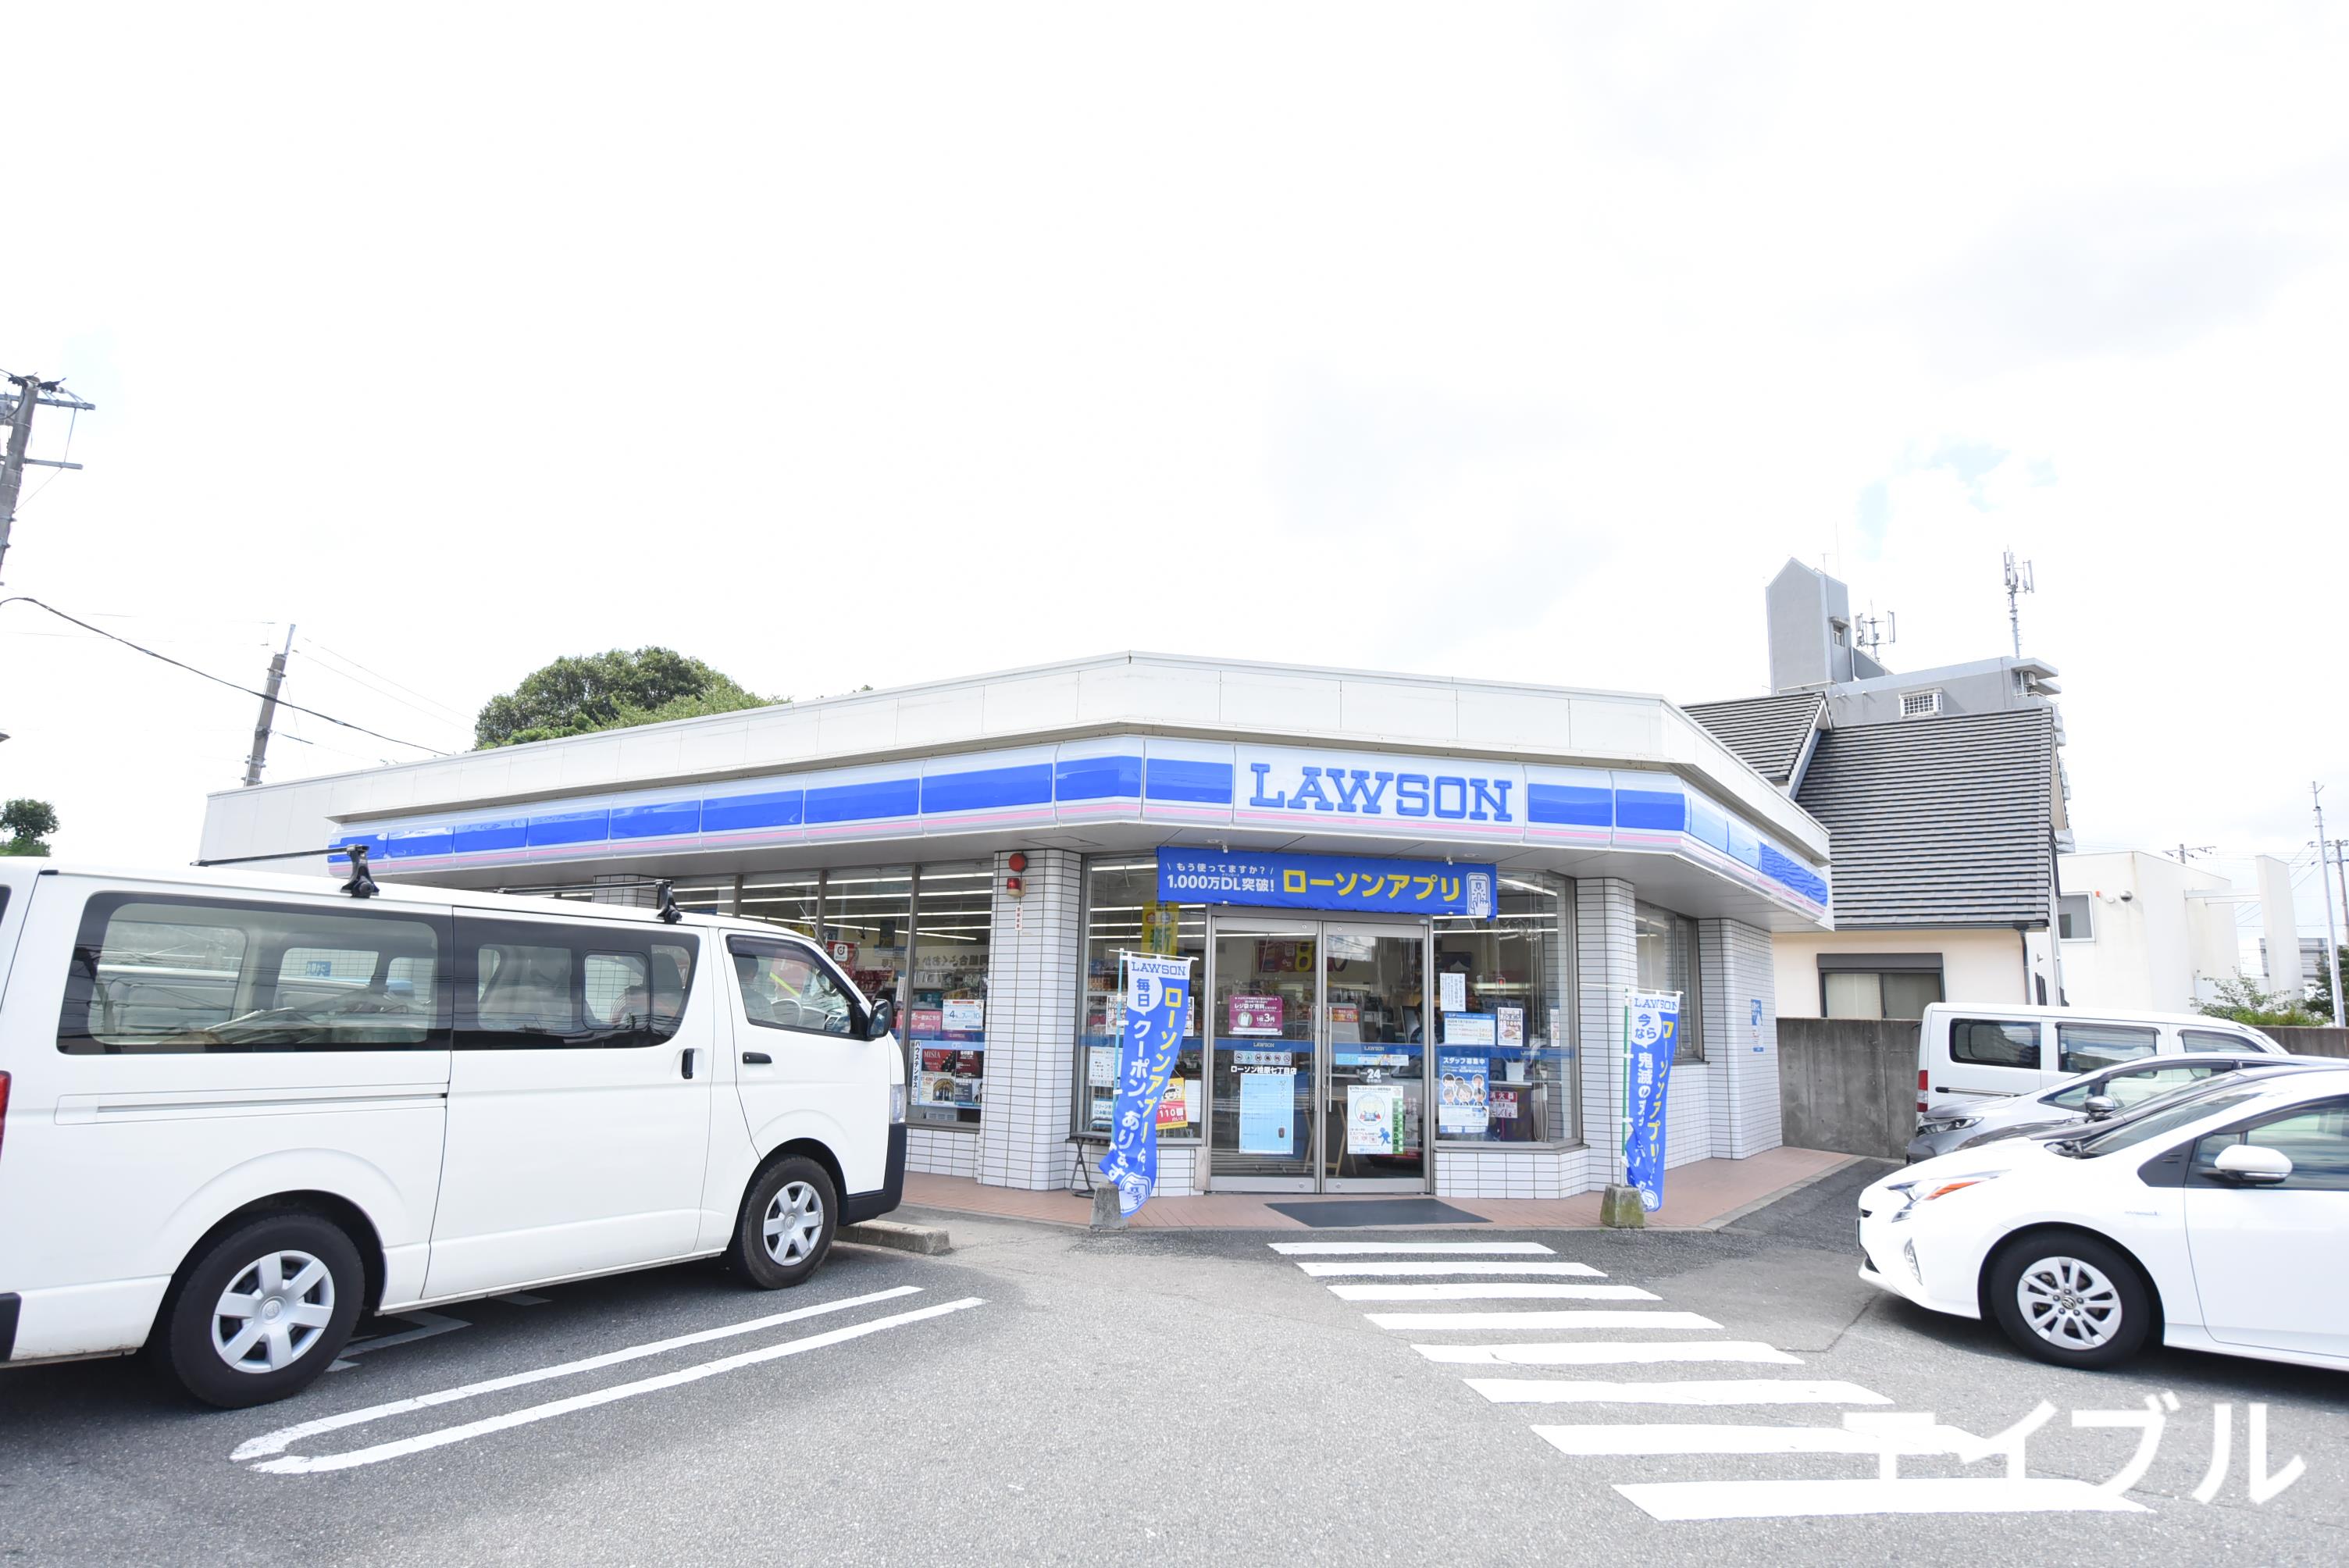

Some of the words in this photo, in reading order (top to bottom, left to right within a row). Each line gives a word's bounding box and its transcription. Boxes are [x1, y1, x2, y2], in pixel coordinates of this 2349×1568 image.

[1249, 762, 1513, 822] LAWSON
[1283, 869, 1460, 902] ローソンアプリ
[1132, 961, 1187, 976] LAWSON
[1137, 978, 1150, 1007] 毎日
[1634, 998, 1677, 1011] LAWSON
[924, 1050, 941, 1059] MISIA
[1443, 1057, 1485, 1065] スタッフ募集中
[1367, 1068, 1381, 1079] 24
